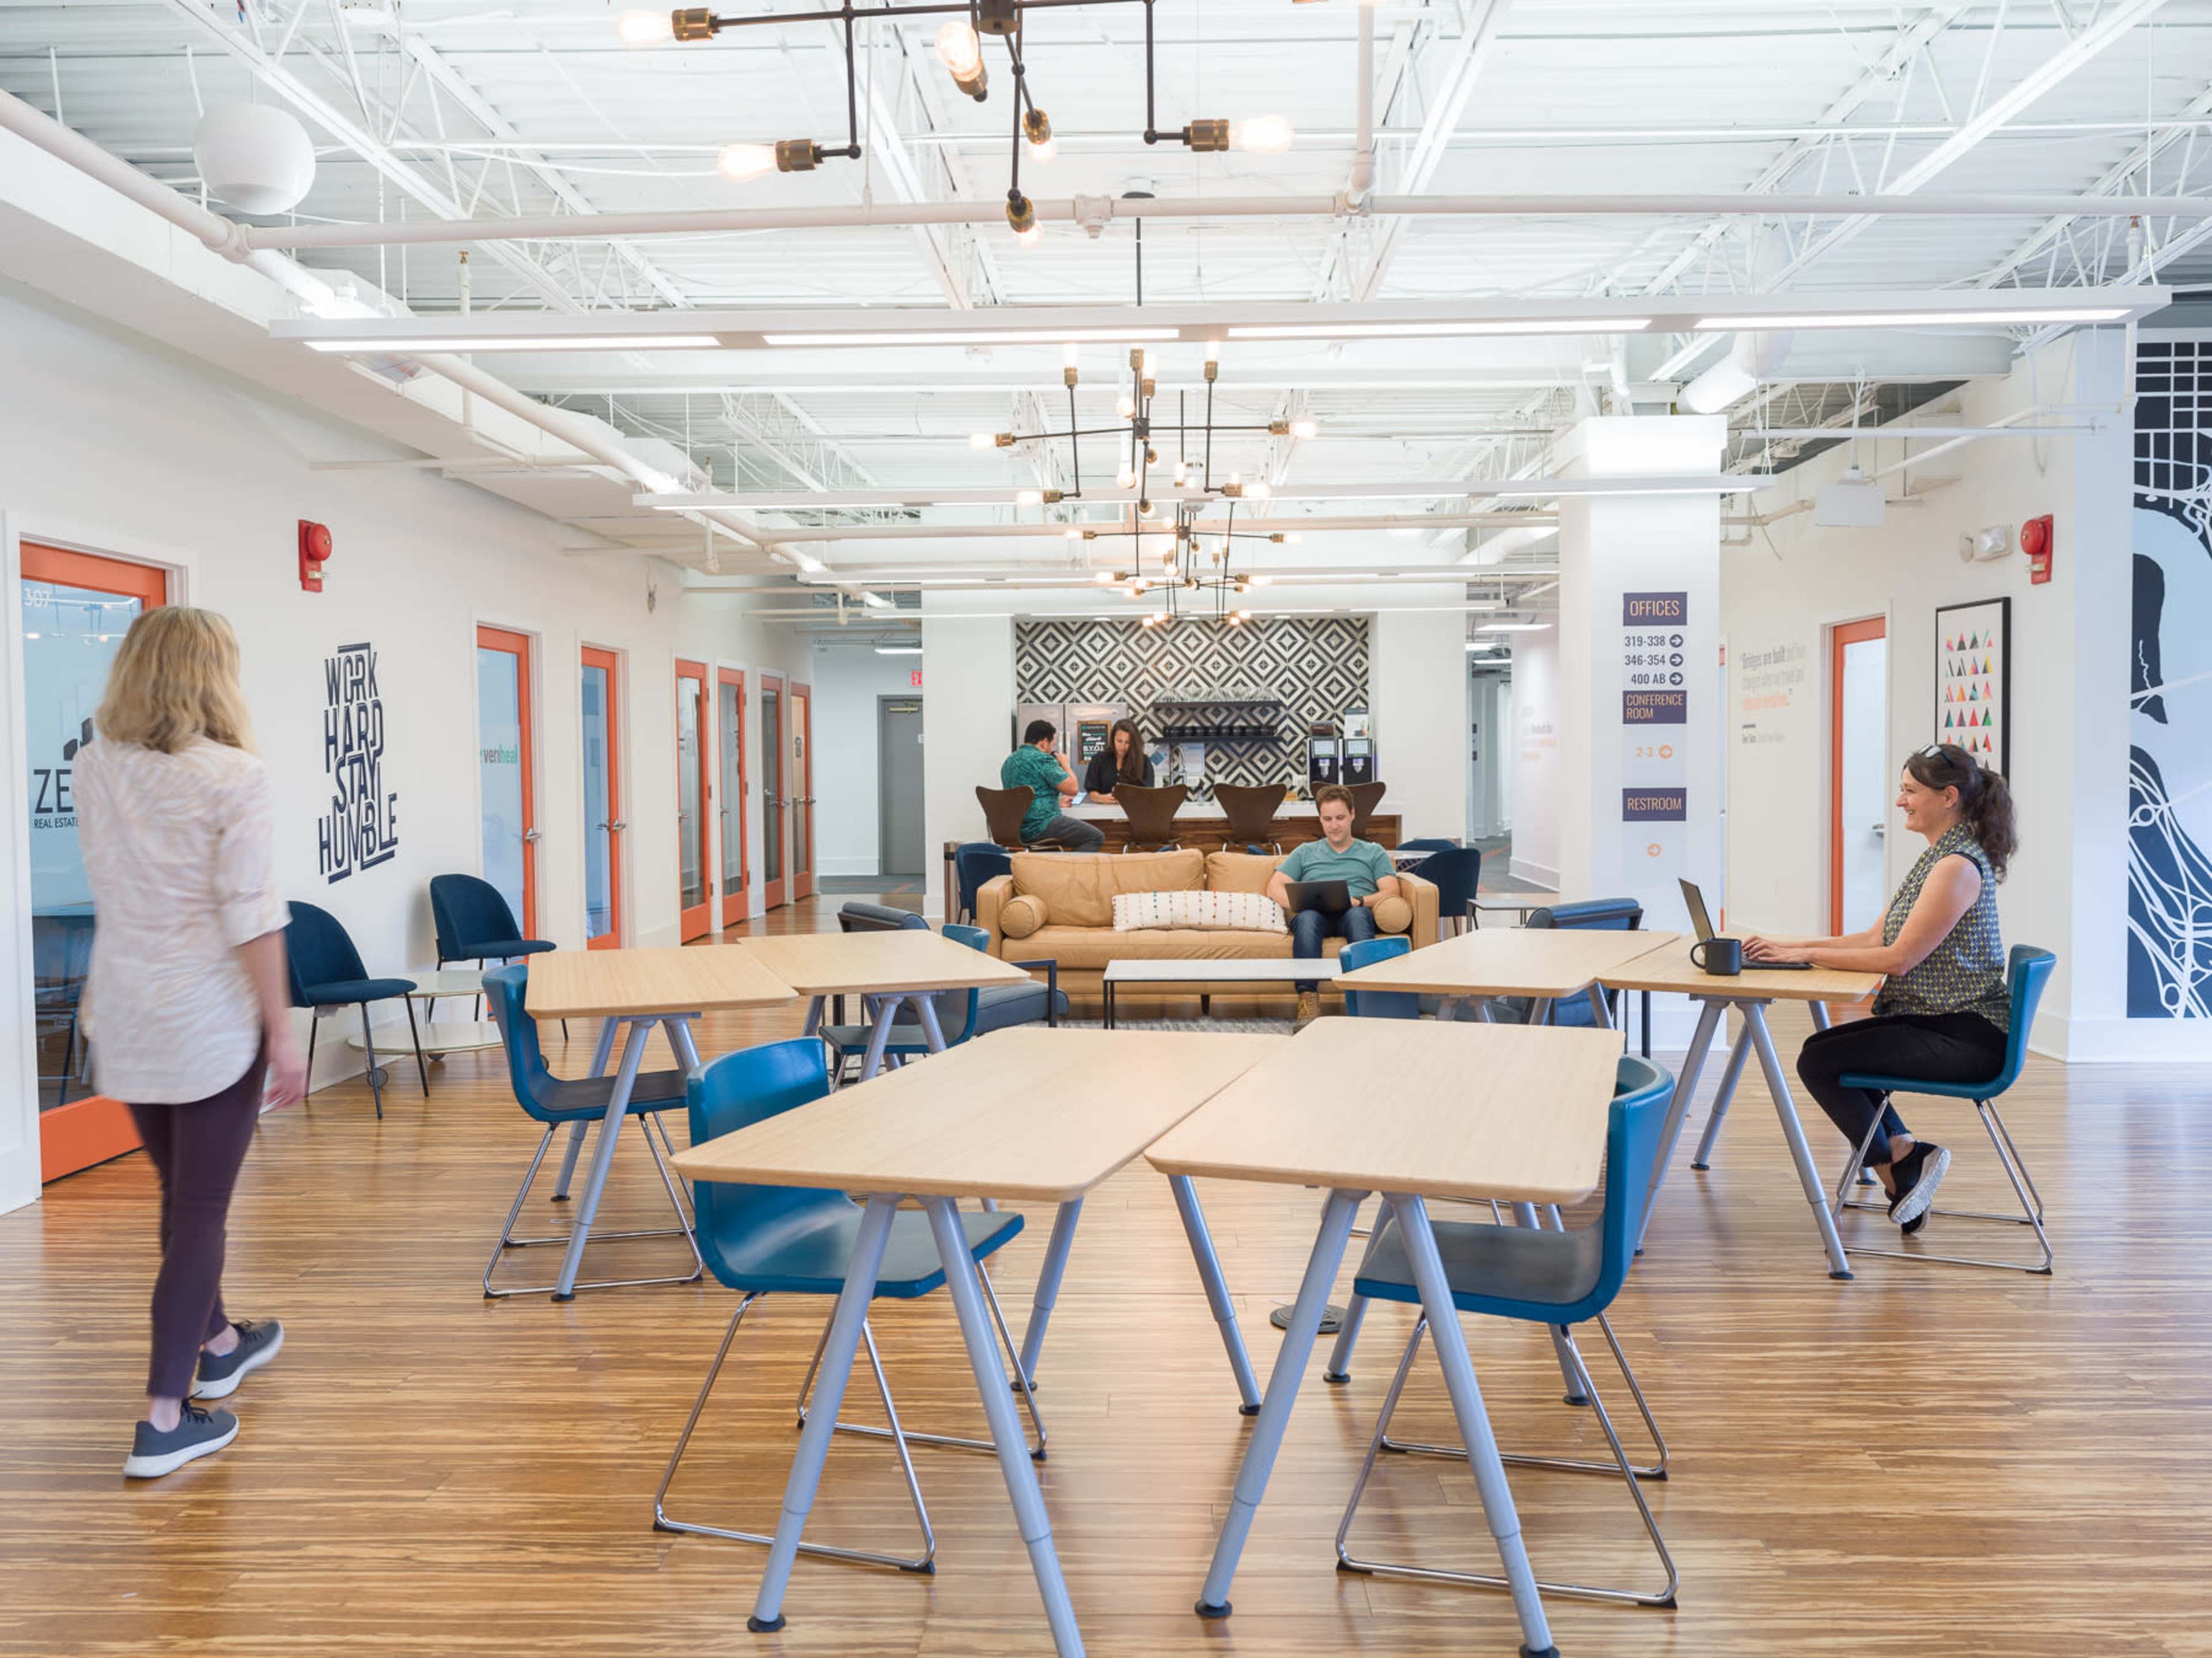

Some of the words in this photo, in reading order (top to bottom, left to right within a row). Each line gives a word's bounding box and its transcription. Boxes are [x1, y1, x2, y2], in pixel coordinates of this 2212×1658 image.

[24, 588, 50, 608] 307
[1630, 600, 1680, 616] OFFICES
[1625, 635, 1666, 647] 319-338
[1625, 654, 1666, 665] 346-354
[324, 642, 378, 706] WORK
[911, 670, 922, 686] EX
[1631, 673, 1650, 684] 400
[1653, 673, 1666, 684] AB
[1626, 694, 1683, 706] CONFERENCE
[1626, 707, 1654, 719] ROOM
[324, 699, 384, 773] HARD
[335, 751, 377, 813] STAY
[33, 769, 74, 813] ZE
[1627, 797, 1682, 811] RESTROOM
[34, 818, 53, 829] REAL
[318, 775, 398, 884] HUMBLE
